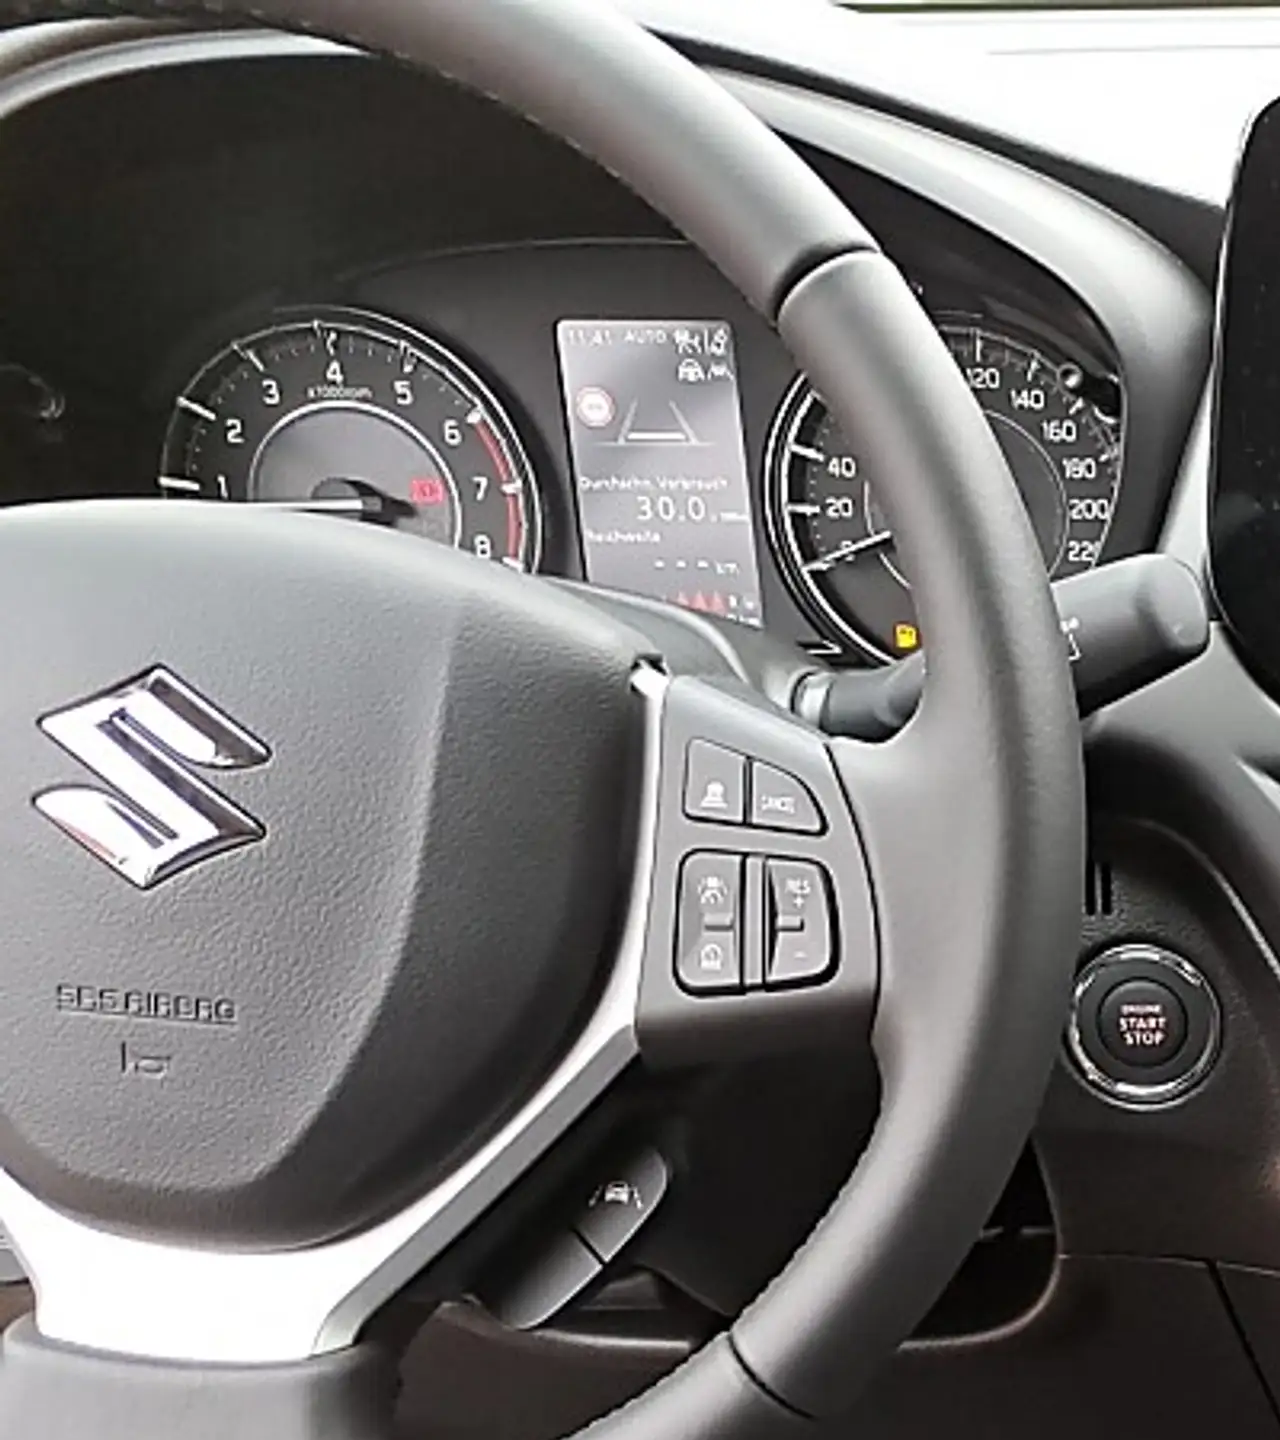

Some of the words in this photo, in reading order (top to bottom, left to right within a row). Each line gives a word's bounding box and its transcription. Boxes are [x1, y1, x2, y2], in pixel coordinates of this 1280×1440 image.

[326, 361, 343, 383] 4
[262, 381, 280, 405] 3
[395, 381, 413, 405] 5
[1011, 389, 1045, 410] 140
[226, 419, 244, 443] 2
[444, 420, 461, 444] 6
[1042, 421, 1077, 442] 160
[827, 458, 856, 478] 40
[216, 476, 229, 499] 1
[472, 476, 488, 500] 7
[825, 499, 853, 518] 20
[1069, 499, 1109, 520] 200
[474, 534, 491, 559] 8
[1119, 1018, 1166, 1031] START
[1124, 1033, 1164, 1045] STOP
